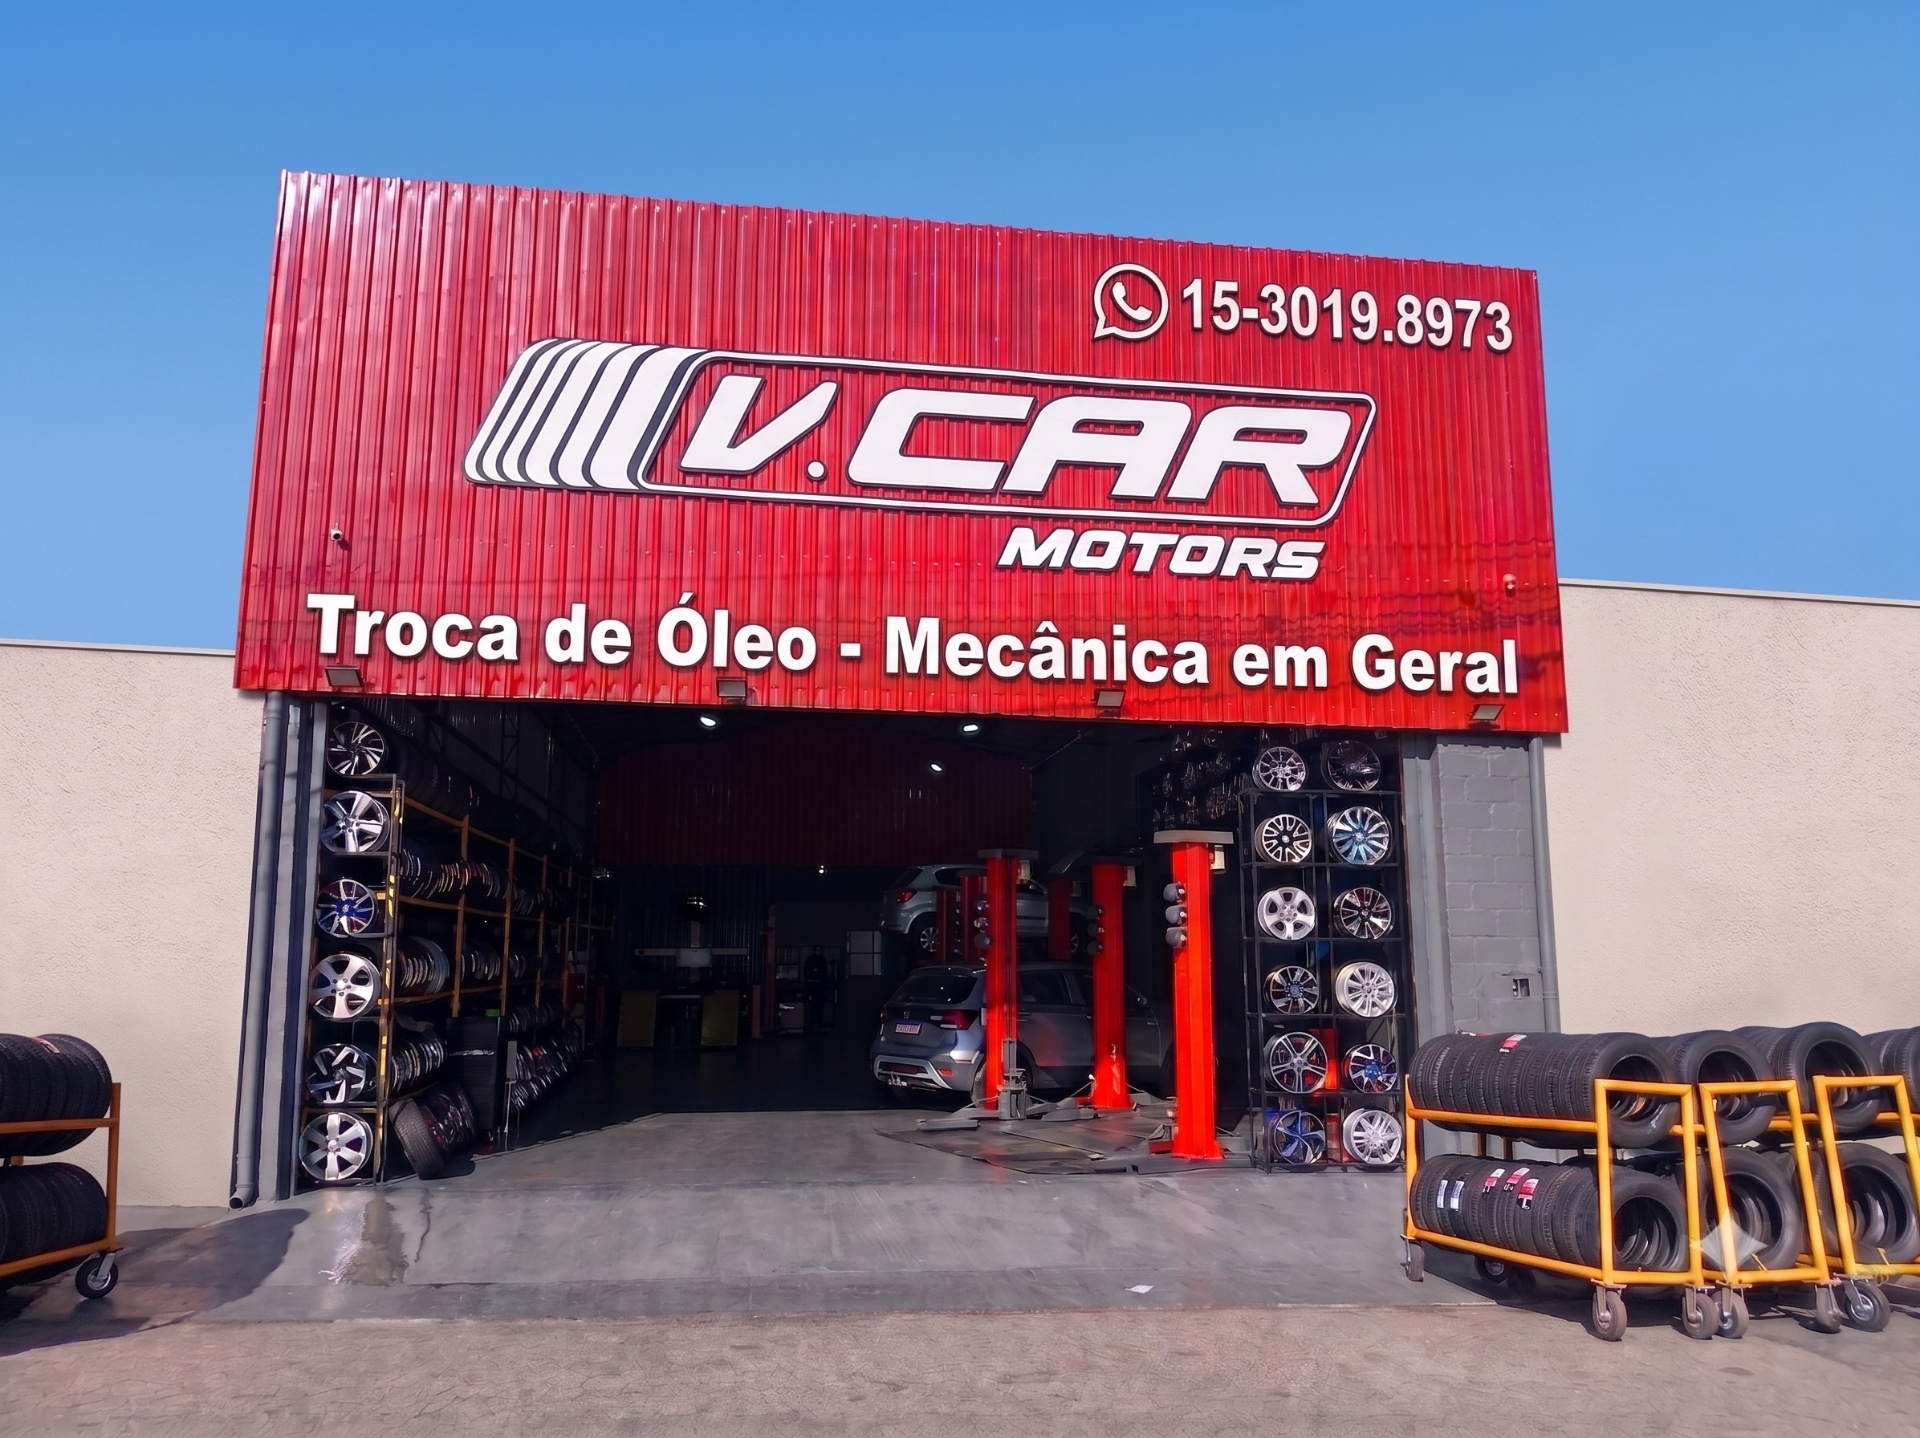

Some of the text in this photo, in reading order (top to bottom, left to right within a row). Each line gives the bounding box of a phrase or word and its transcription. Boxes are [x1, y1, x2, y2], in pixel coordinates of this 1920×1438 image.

[1182, 277, 1515, 352] 15-3019.8973
[997, 526, 1326, 580] MOTORS
[305, 591, 1519, 695] Troca de Óleo - Mecânica em Geral
